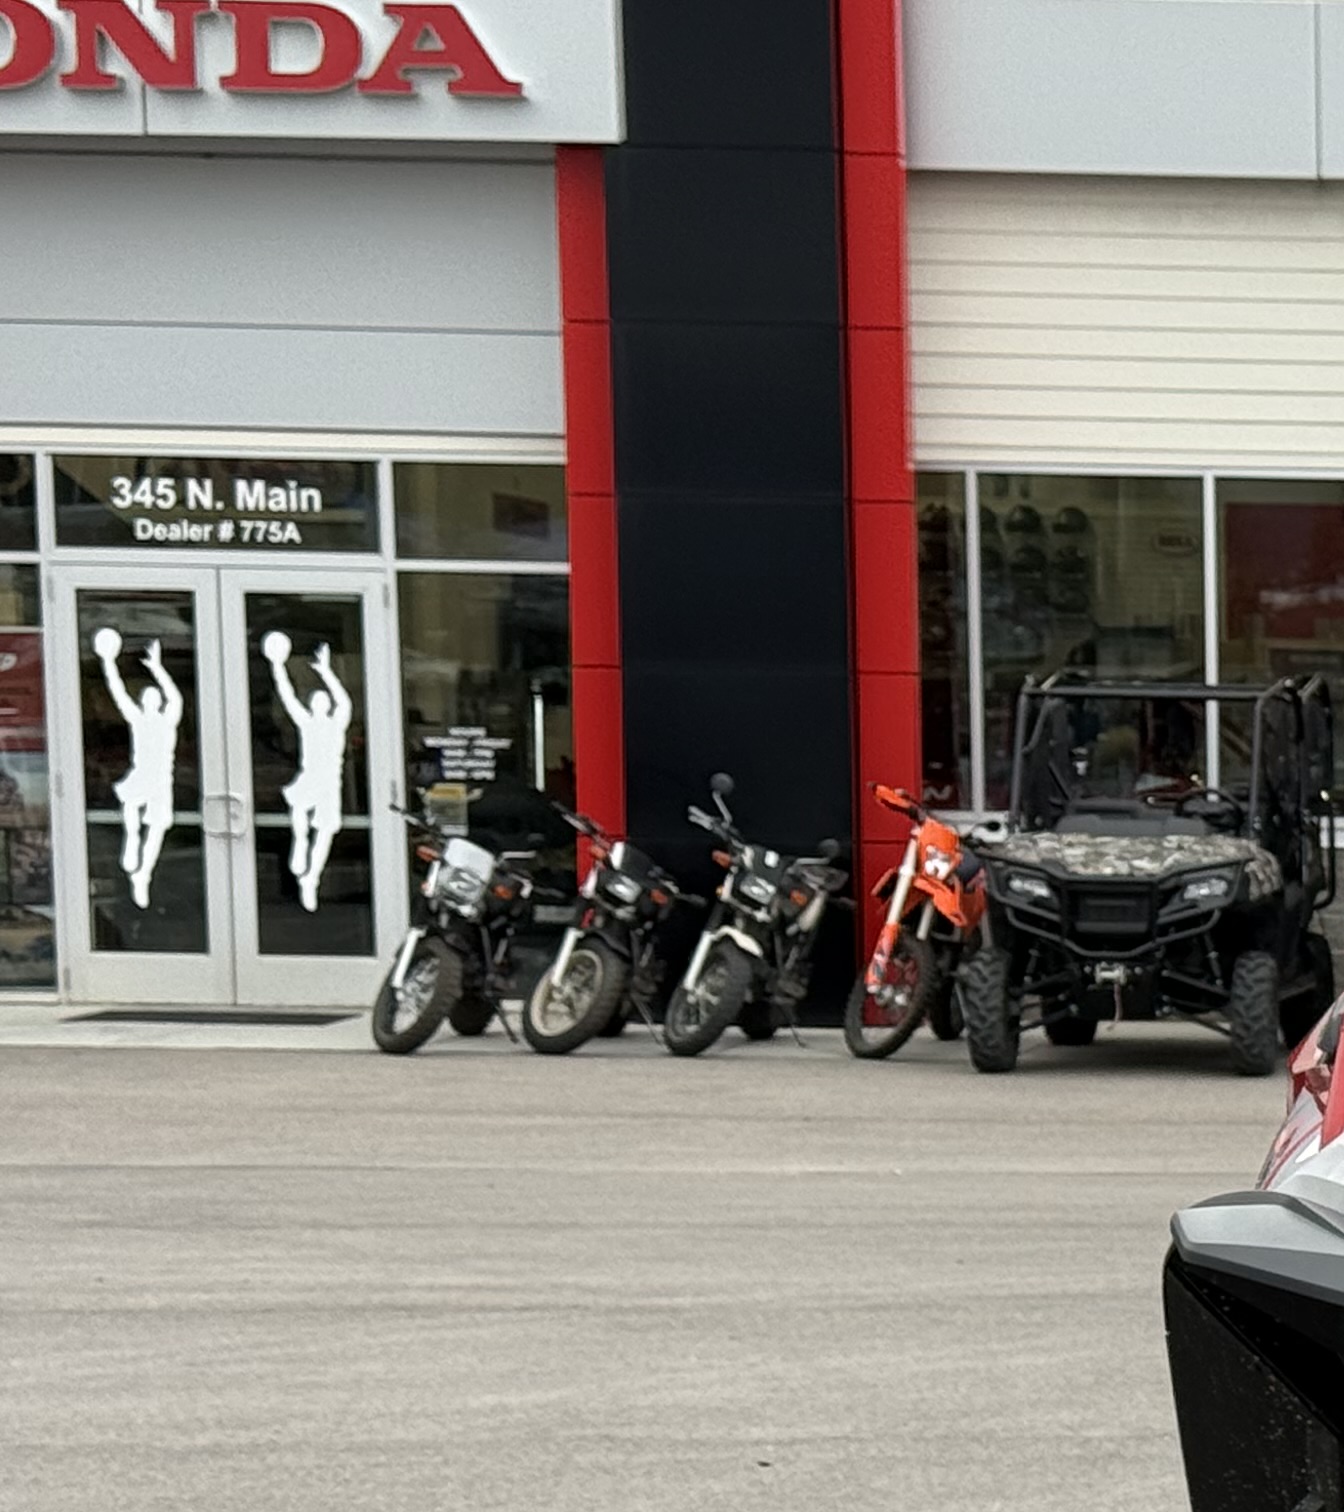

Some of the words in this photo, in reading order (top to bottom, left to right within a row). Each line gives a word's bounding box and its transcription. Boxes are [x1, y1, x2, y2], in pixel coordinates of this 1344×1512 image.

[111, 476, 177, 510] 345
[186, 477, 225, 511] N.
[234, 478, 322, 513] Main
[133, 518, 214, 542] Dealer
[217, 519, 235, 543] #
[240, 519, 302, 545] 775A
